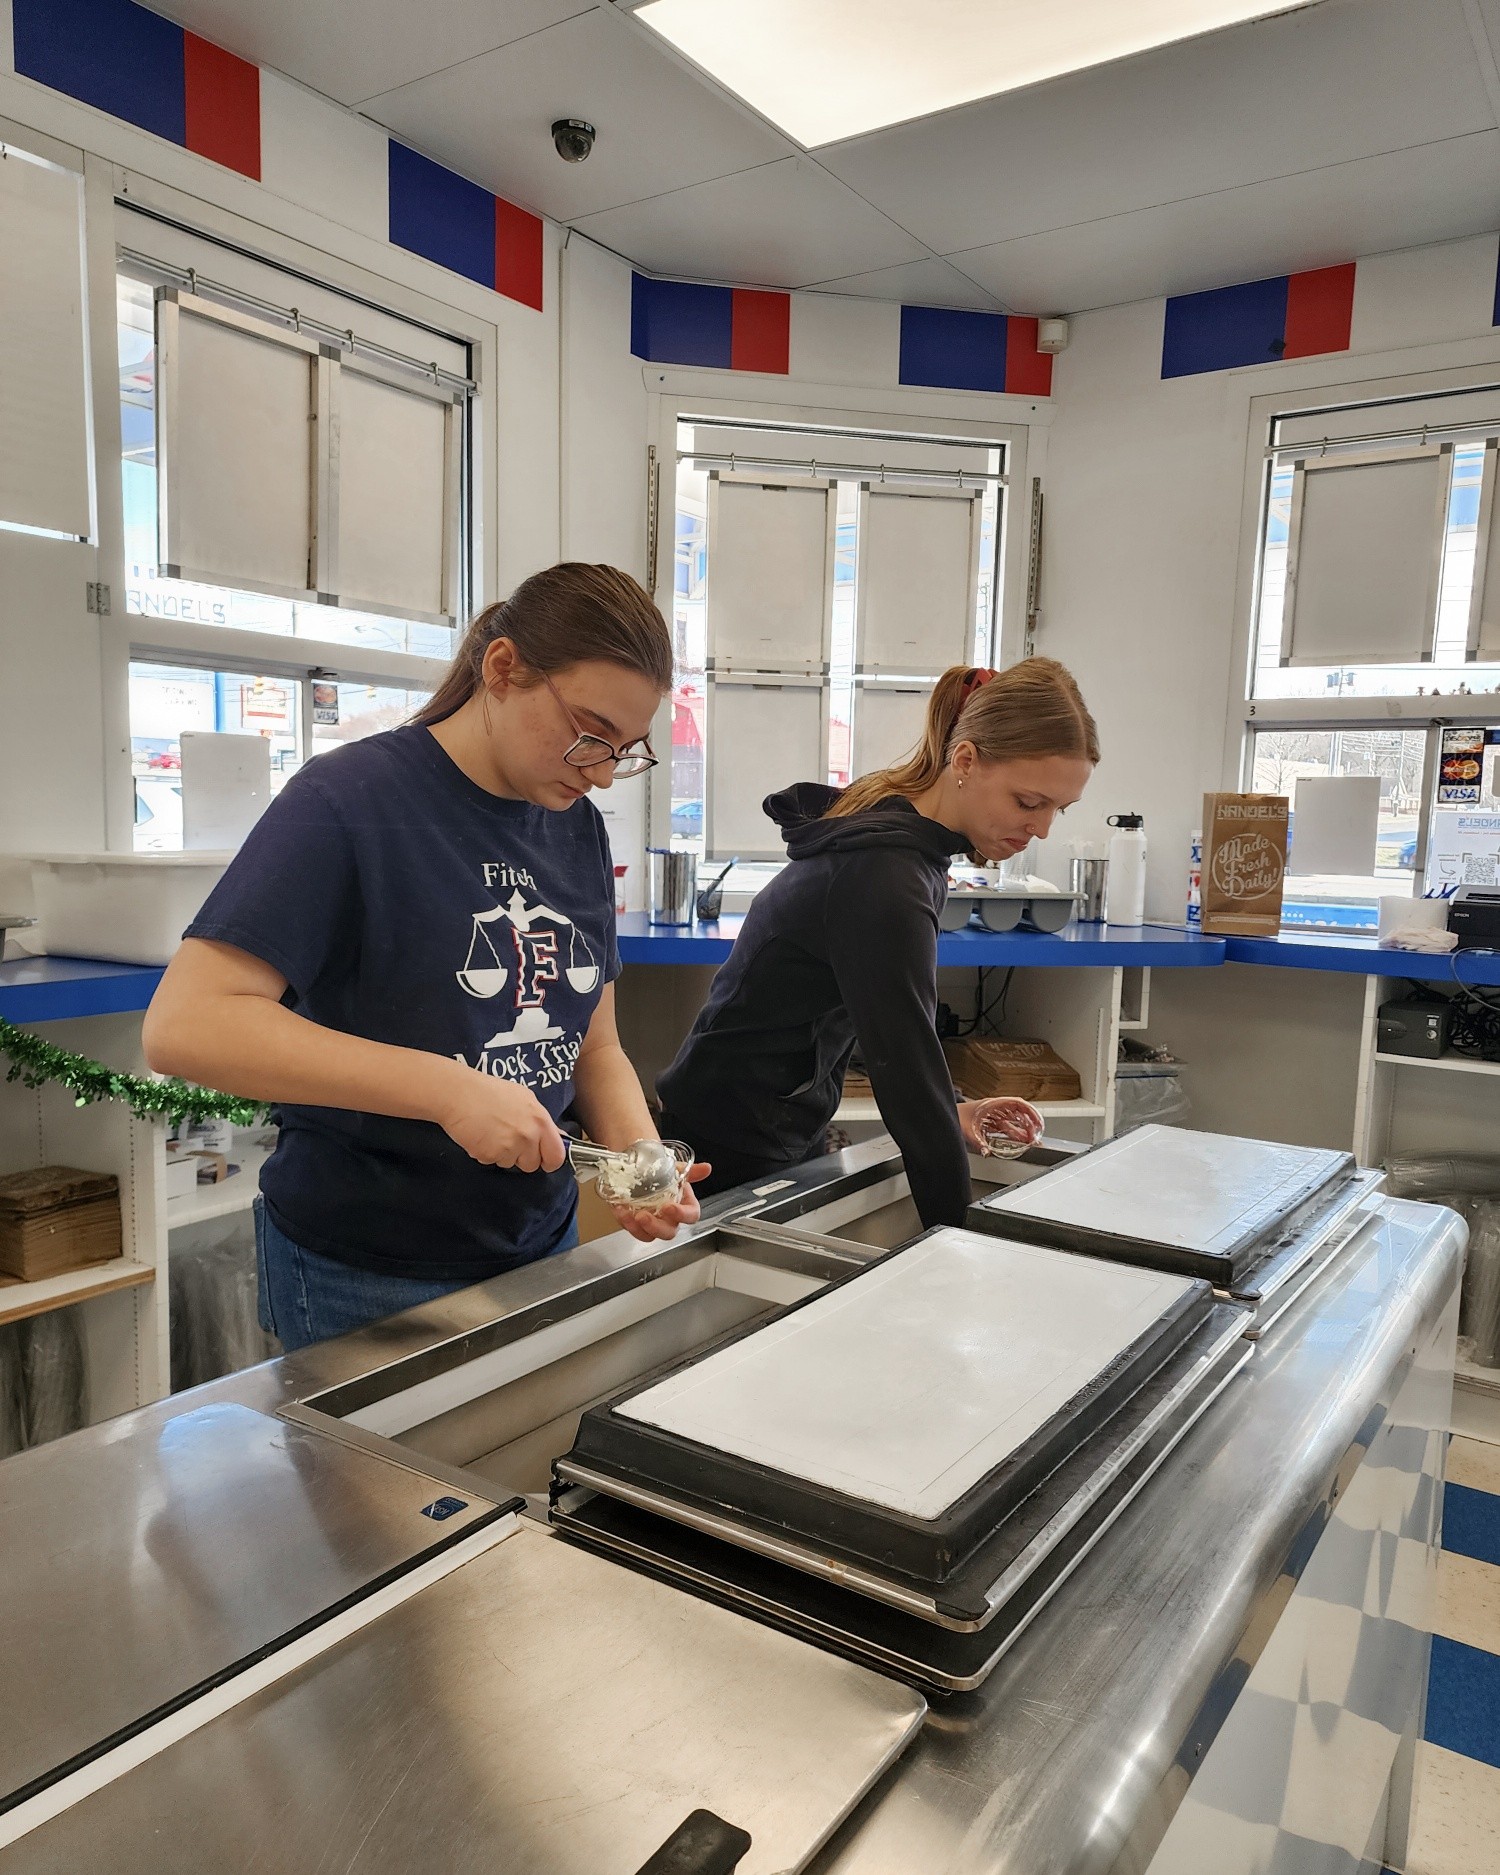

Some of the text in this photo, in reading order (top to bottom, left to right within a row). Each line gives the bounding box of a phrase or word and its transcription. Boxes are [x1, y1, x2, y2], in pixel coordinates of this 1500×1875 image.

[1249, 705, 1256, 716] 3
[1442, 788, 1477, 799] VISA
[1219, 834, 1270, 863] Made
[481, 863, 538, 891] Fitch
[1224, 852, 1270, 877] Fresh
[1222, 868, 1278, 896] Daily!
[511, 926, 559, 1009] F
[452, 1046, 533, 1079] Mock
